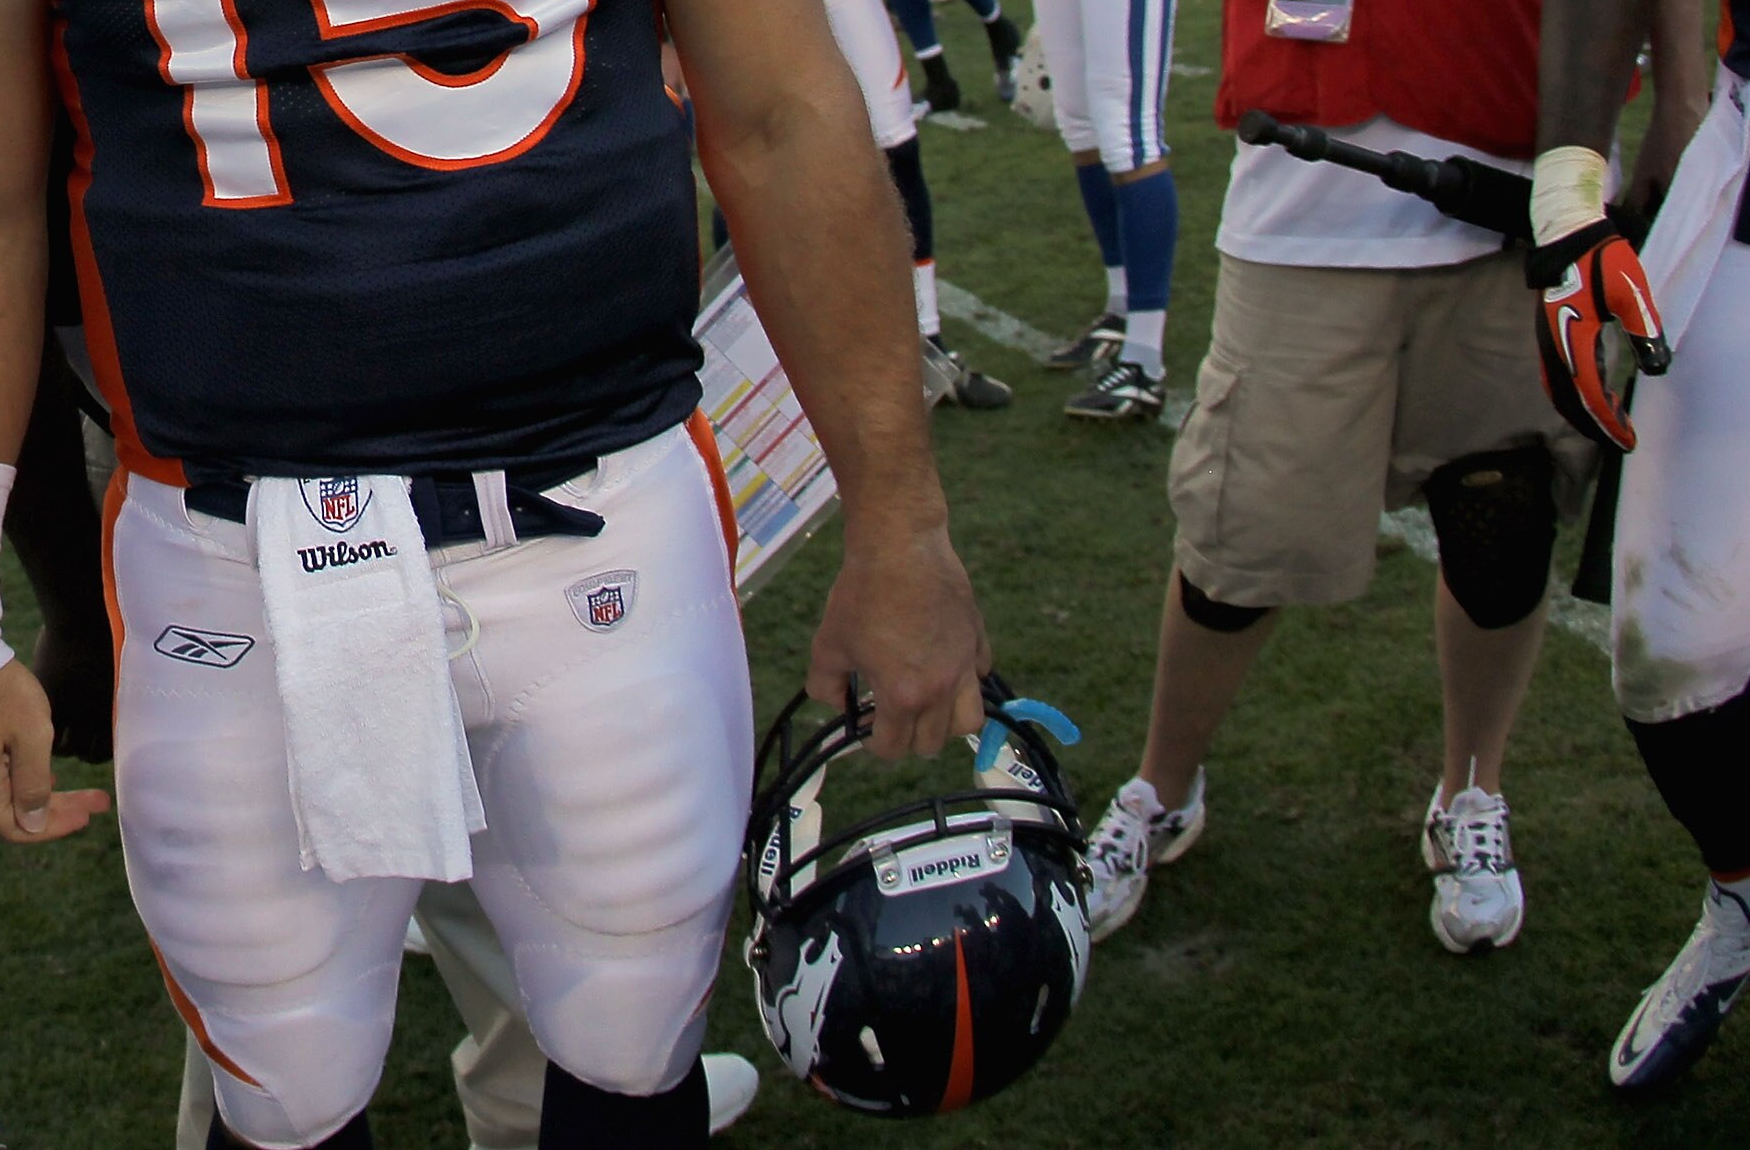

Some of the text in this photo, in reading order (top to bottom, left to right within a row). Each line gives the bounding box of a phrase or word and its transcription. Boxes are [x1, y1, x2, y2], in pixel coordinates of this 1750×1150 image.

[322, 495, 356, 521] NFL
[296, 540, 393, 573] Wilson
[593, 603, 623, 623] NFL
[911, 853, 981, 882] Riddell
